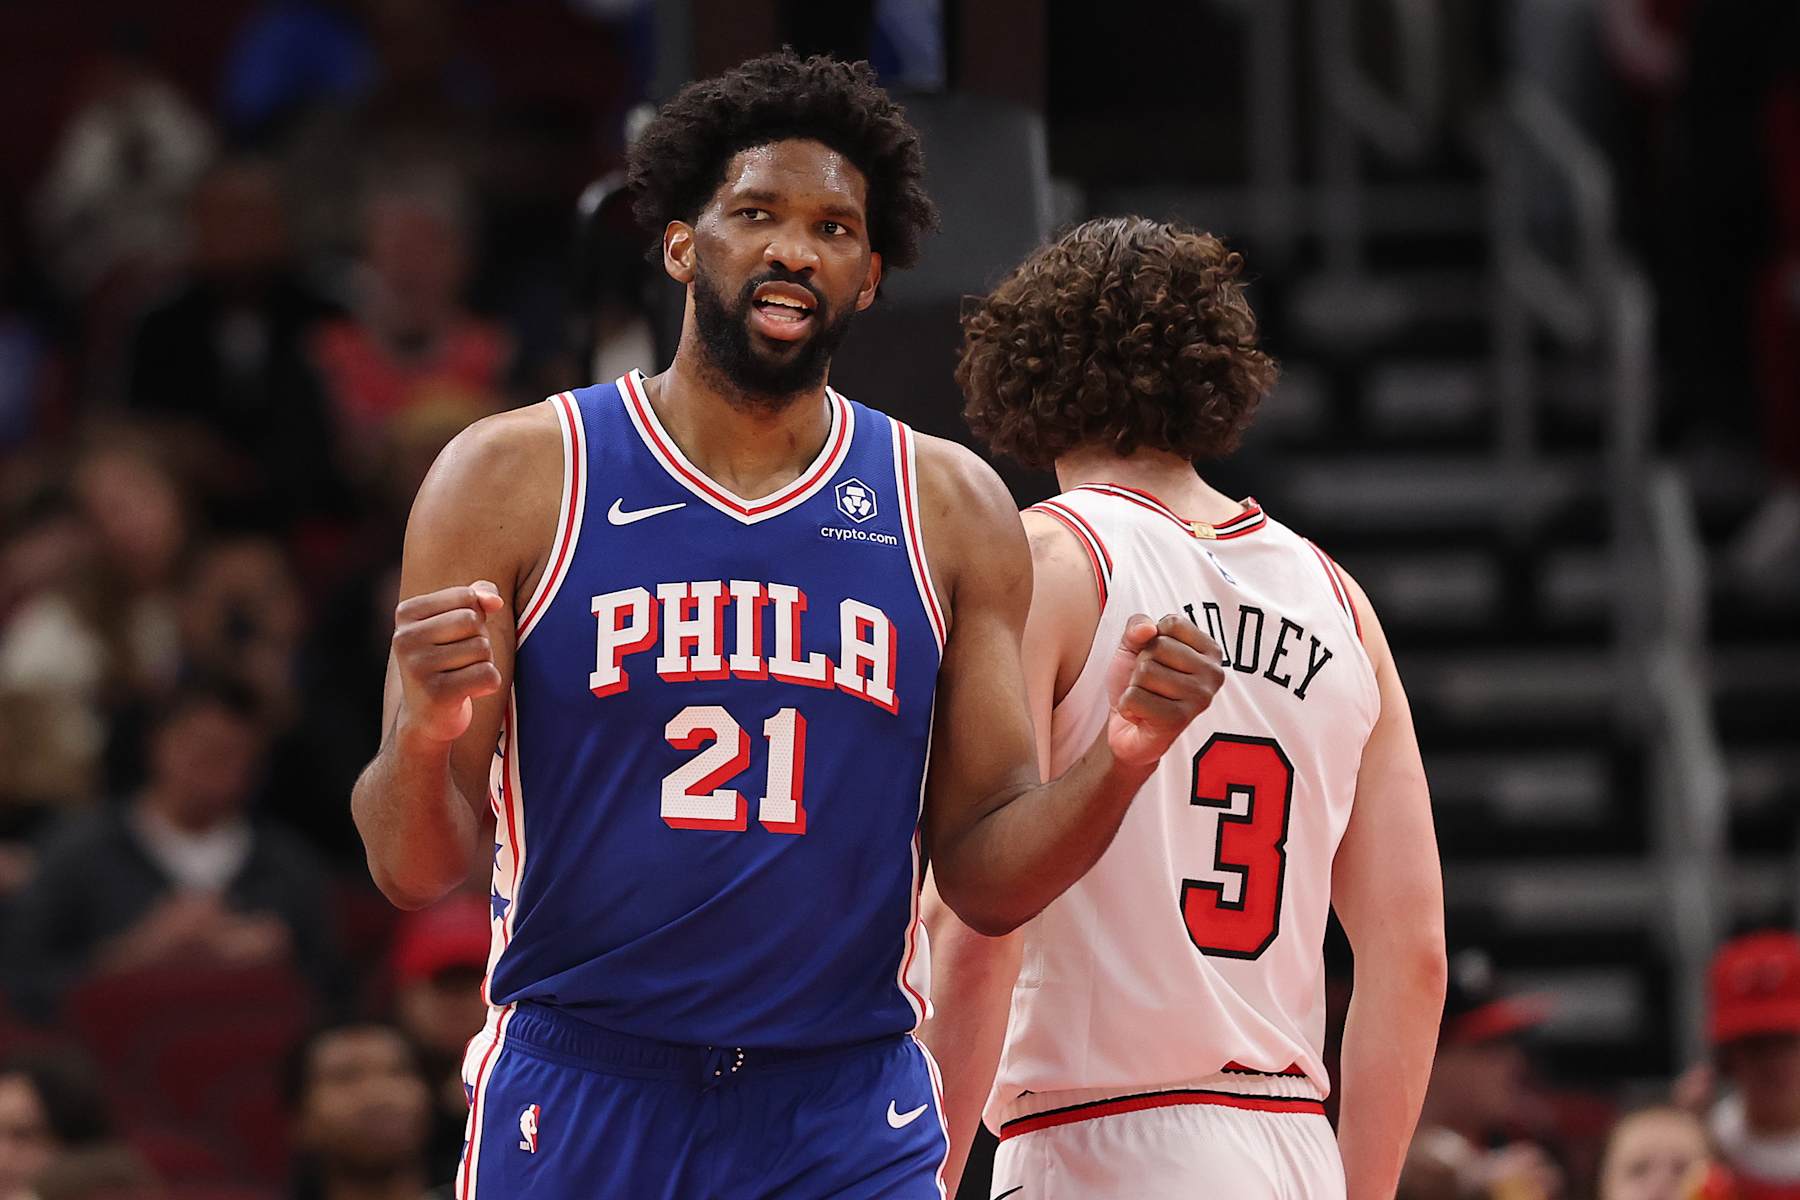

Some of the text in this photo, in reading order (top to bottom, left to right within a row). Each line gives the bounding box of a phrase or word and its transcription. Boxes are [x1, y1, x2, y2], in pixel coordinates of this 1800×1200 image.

[820, 527, 898, 546] crypto.com
[589, 579, 899, 716] PHILA
[1183, 601, 1334, 701] DDEY
[660, 705, 807, 835] 21
[1179, 732, 1295, 961] 3
